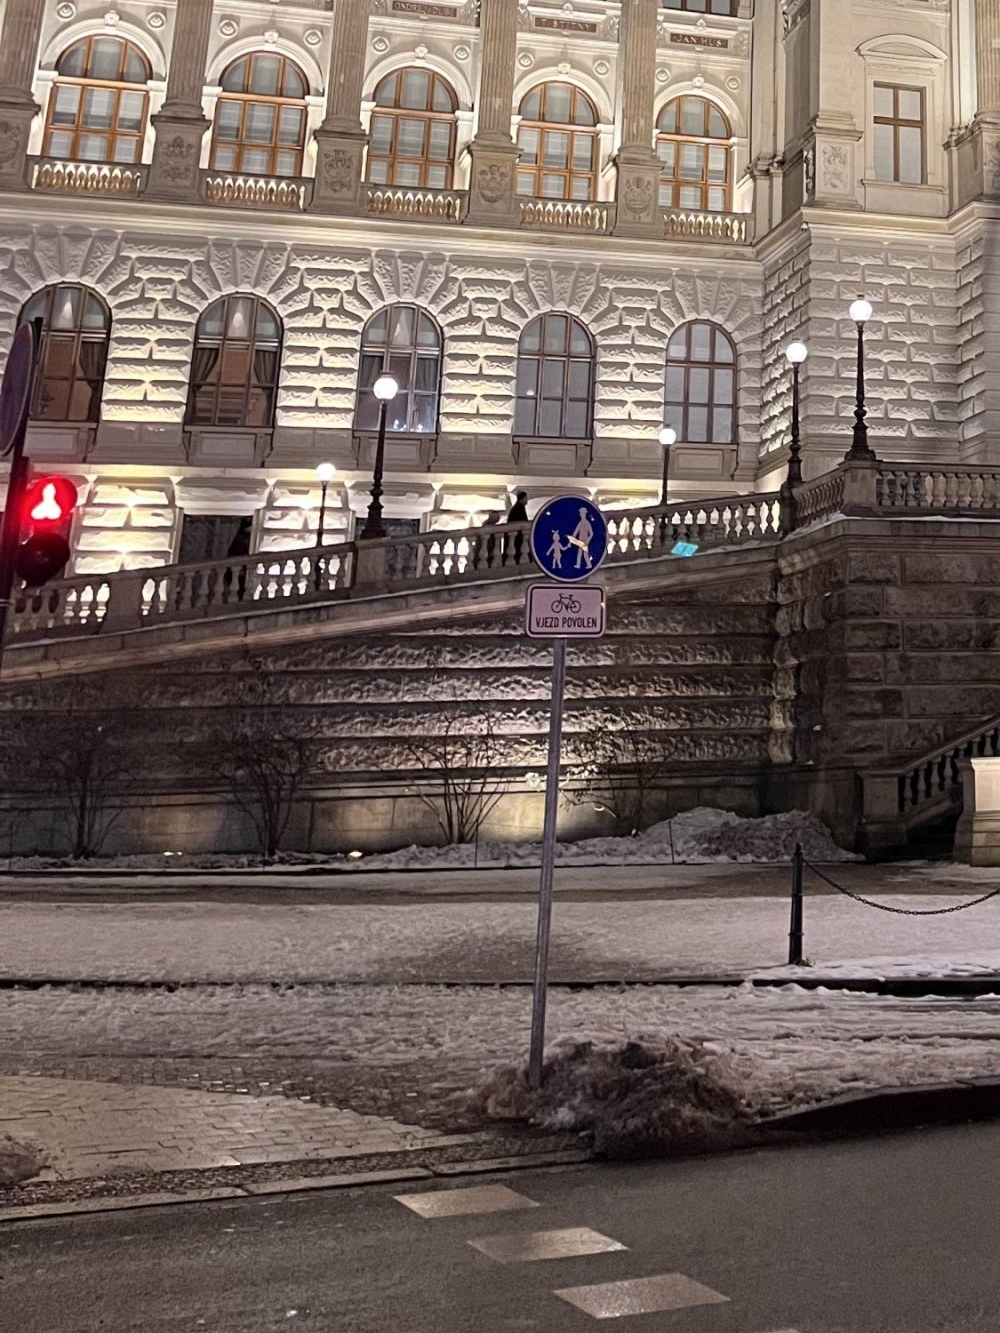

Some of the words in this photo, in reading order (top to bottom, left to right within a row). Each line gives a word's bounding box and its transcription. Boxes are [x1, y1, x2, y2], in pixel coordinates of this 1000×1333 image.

[676, 34, 697, 44] JAN
[700, 37, 722, 47] HUS
[535, 617, 559, 628] VJEZD
[562, 617, 597, 628] POVOLEN
